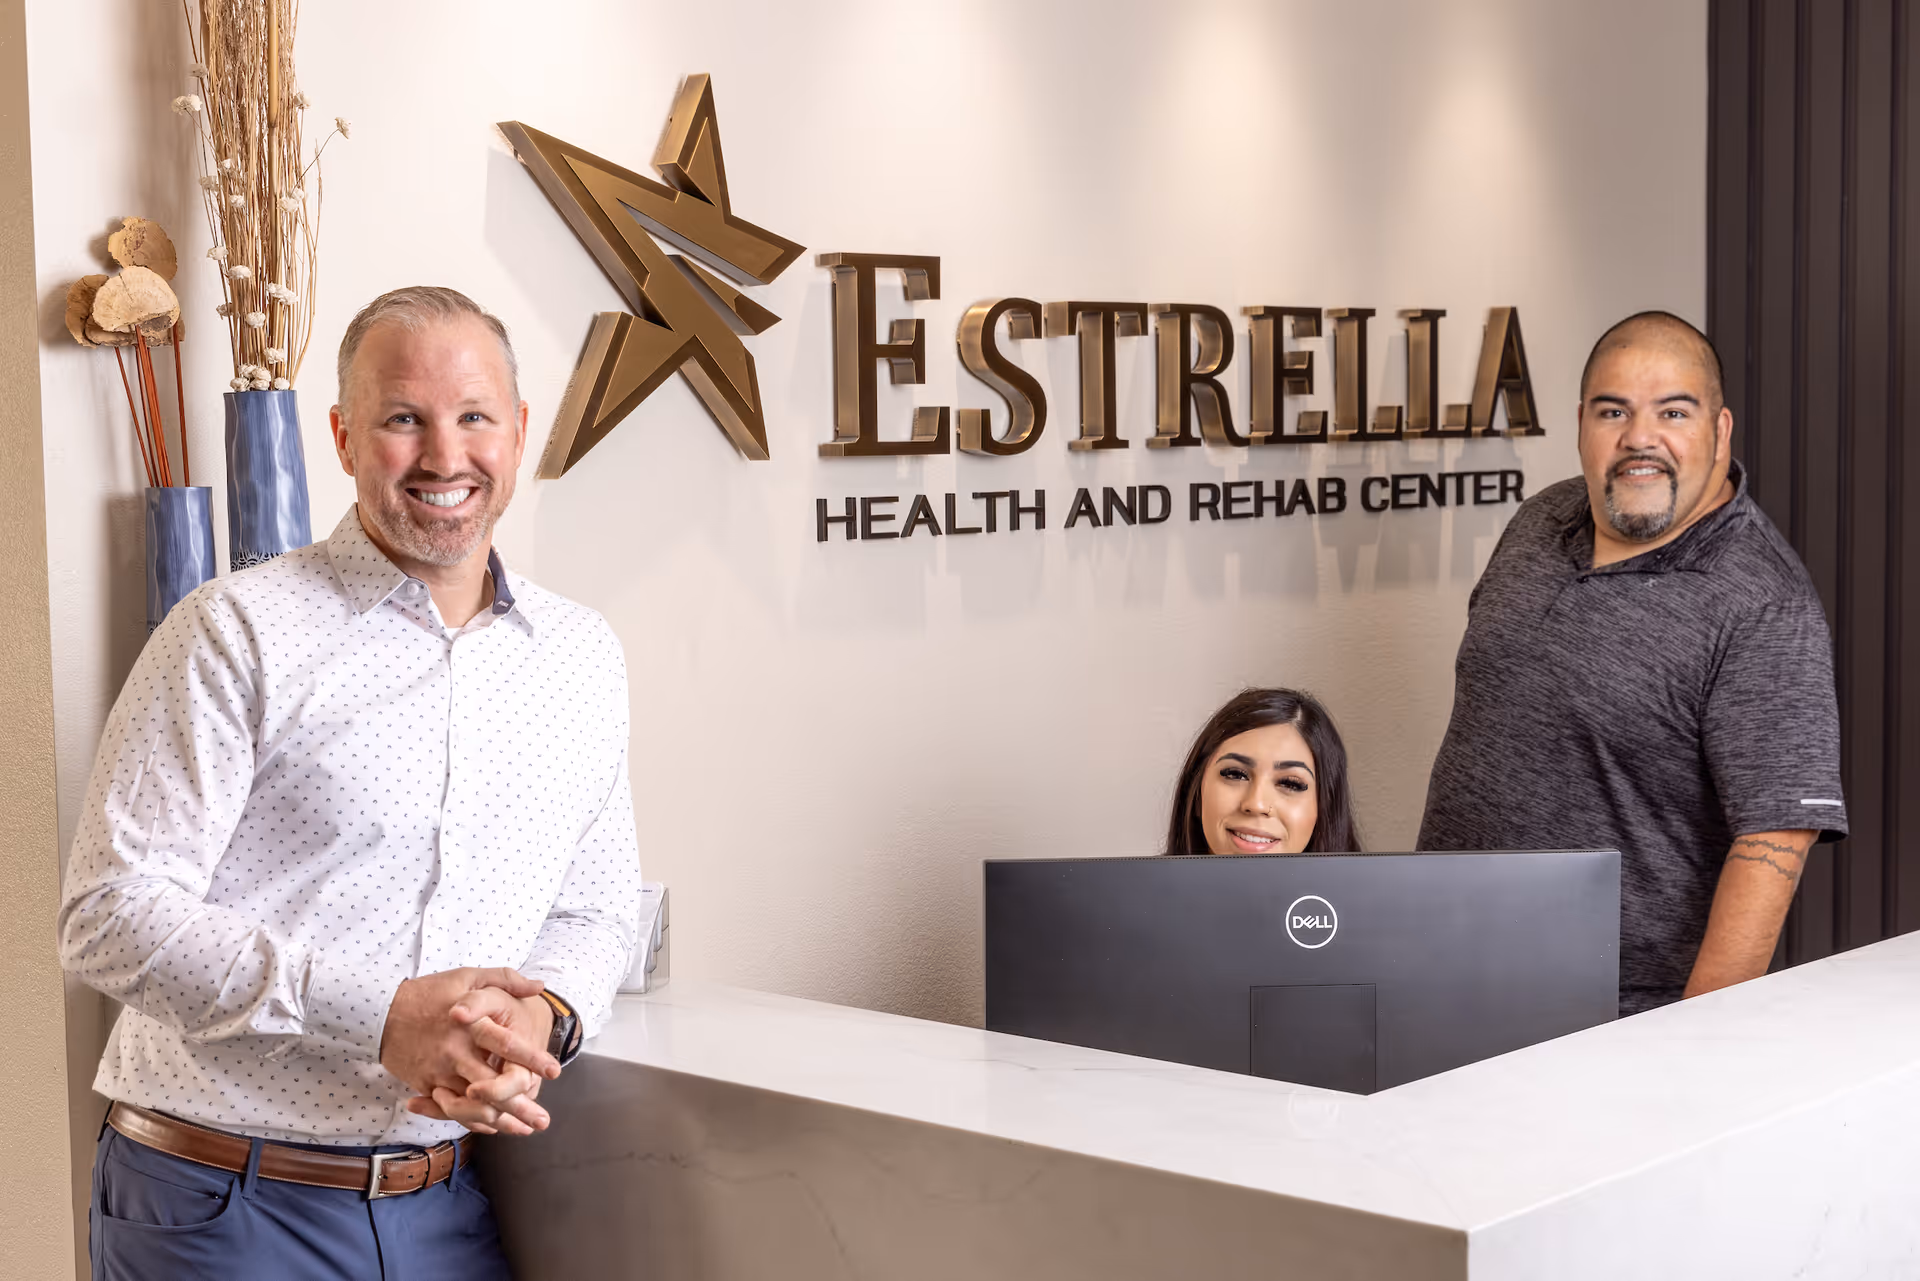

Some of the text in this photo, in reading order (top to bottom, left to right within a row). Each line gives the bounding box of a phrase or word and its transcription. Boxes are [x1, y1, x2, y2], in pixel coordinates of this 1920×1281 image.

[817, 252, 1546, 457] ESTRELLA
[816, 469, 1526, 542] HEALTH AND REHAB CENTER
[1292, 915, 1332, 929] DELL
